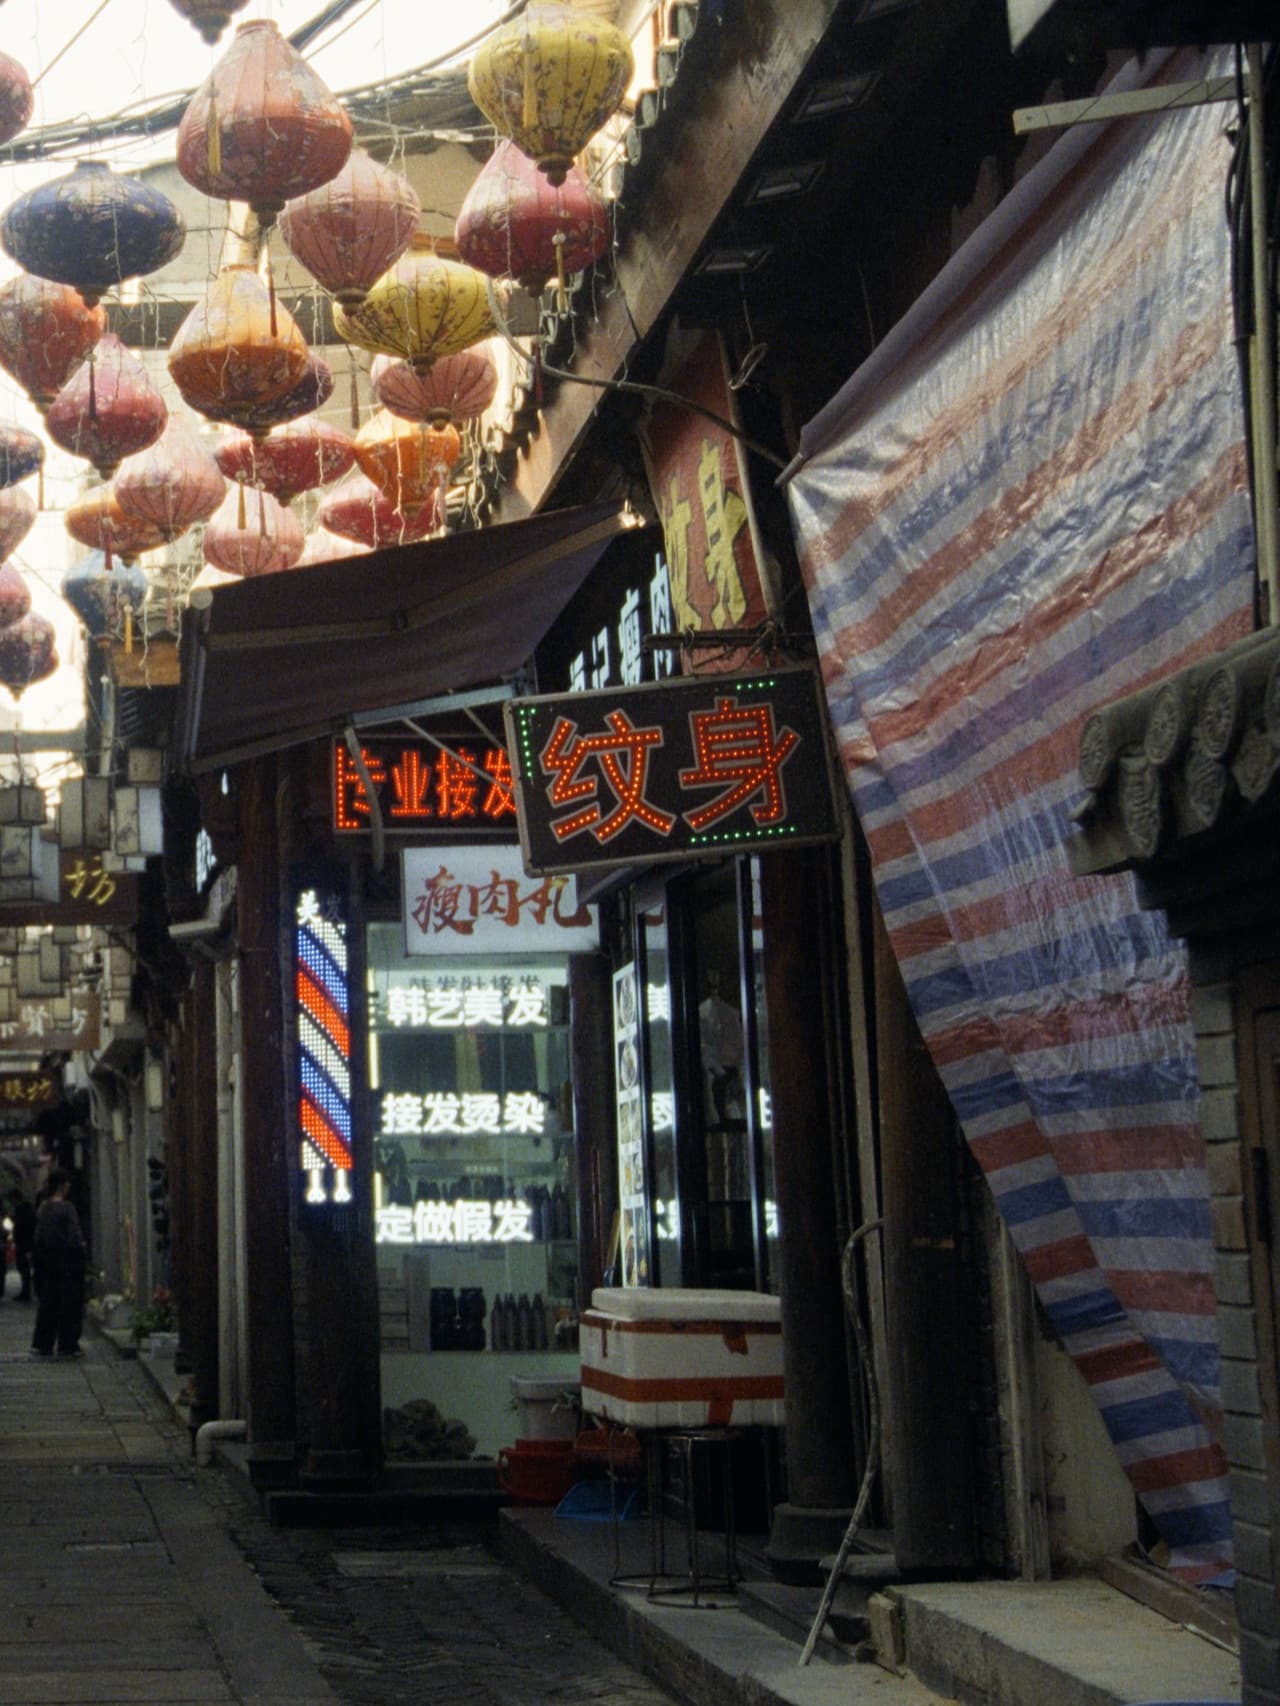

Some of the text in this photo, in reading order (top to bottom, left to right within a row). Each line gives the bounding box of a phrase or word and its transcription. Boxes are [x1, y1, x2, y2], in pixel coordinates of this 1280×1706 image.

[542, 697, 802, 843] 纹身
[412, 866, 593, 935] 瘦肉丸
[387, 986, 548, 1027] 韩艺美发
[381, 1091, 546, 1134] 接发烫染
[376, 1199, 534, 1243] 定做假发
